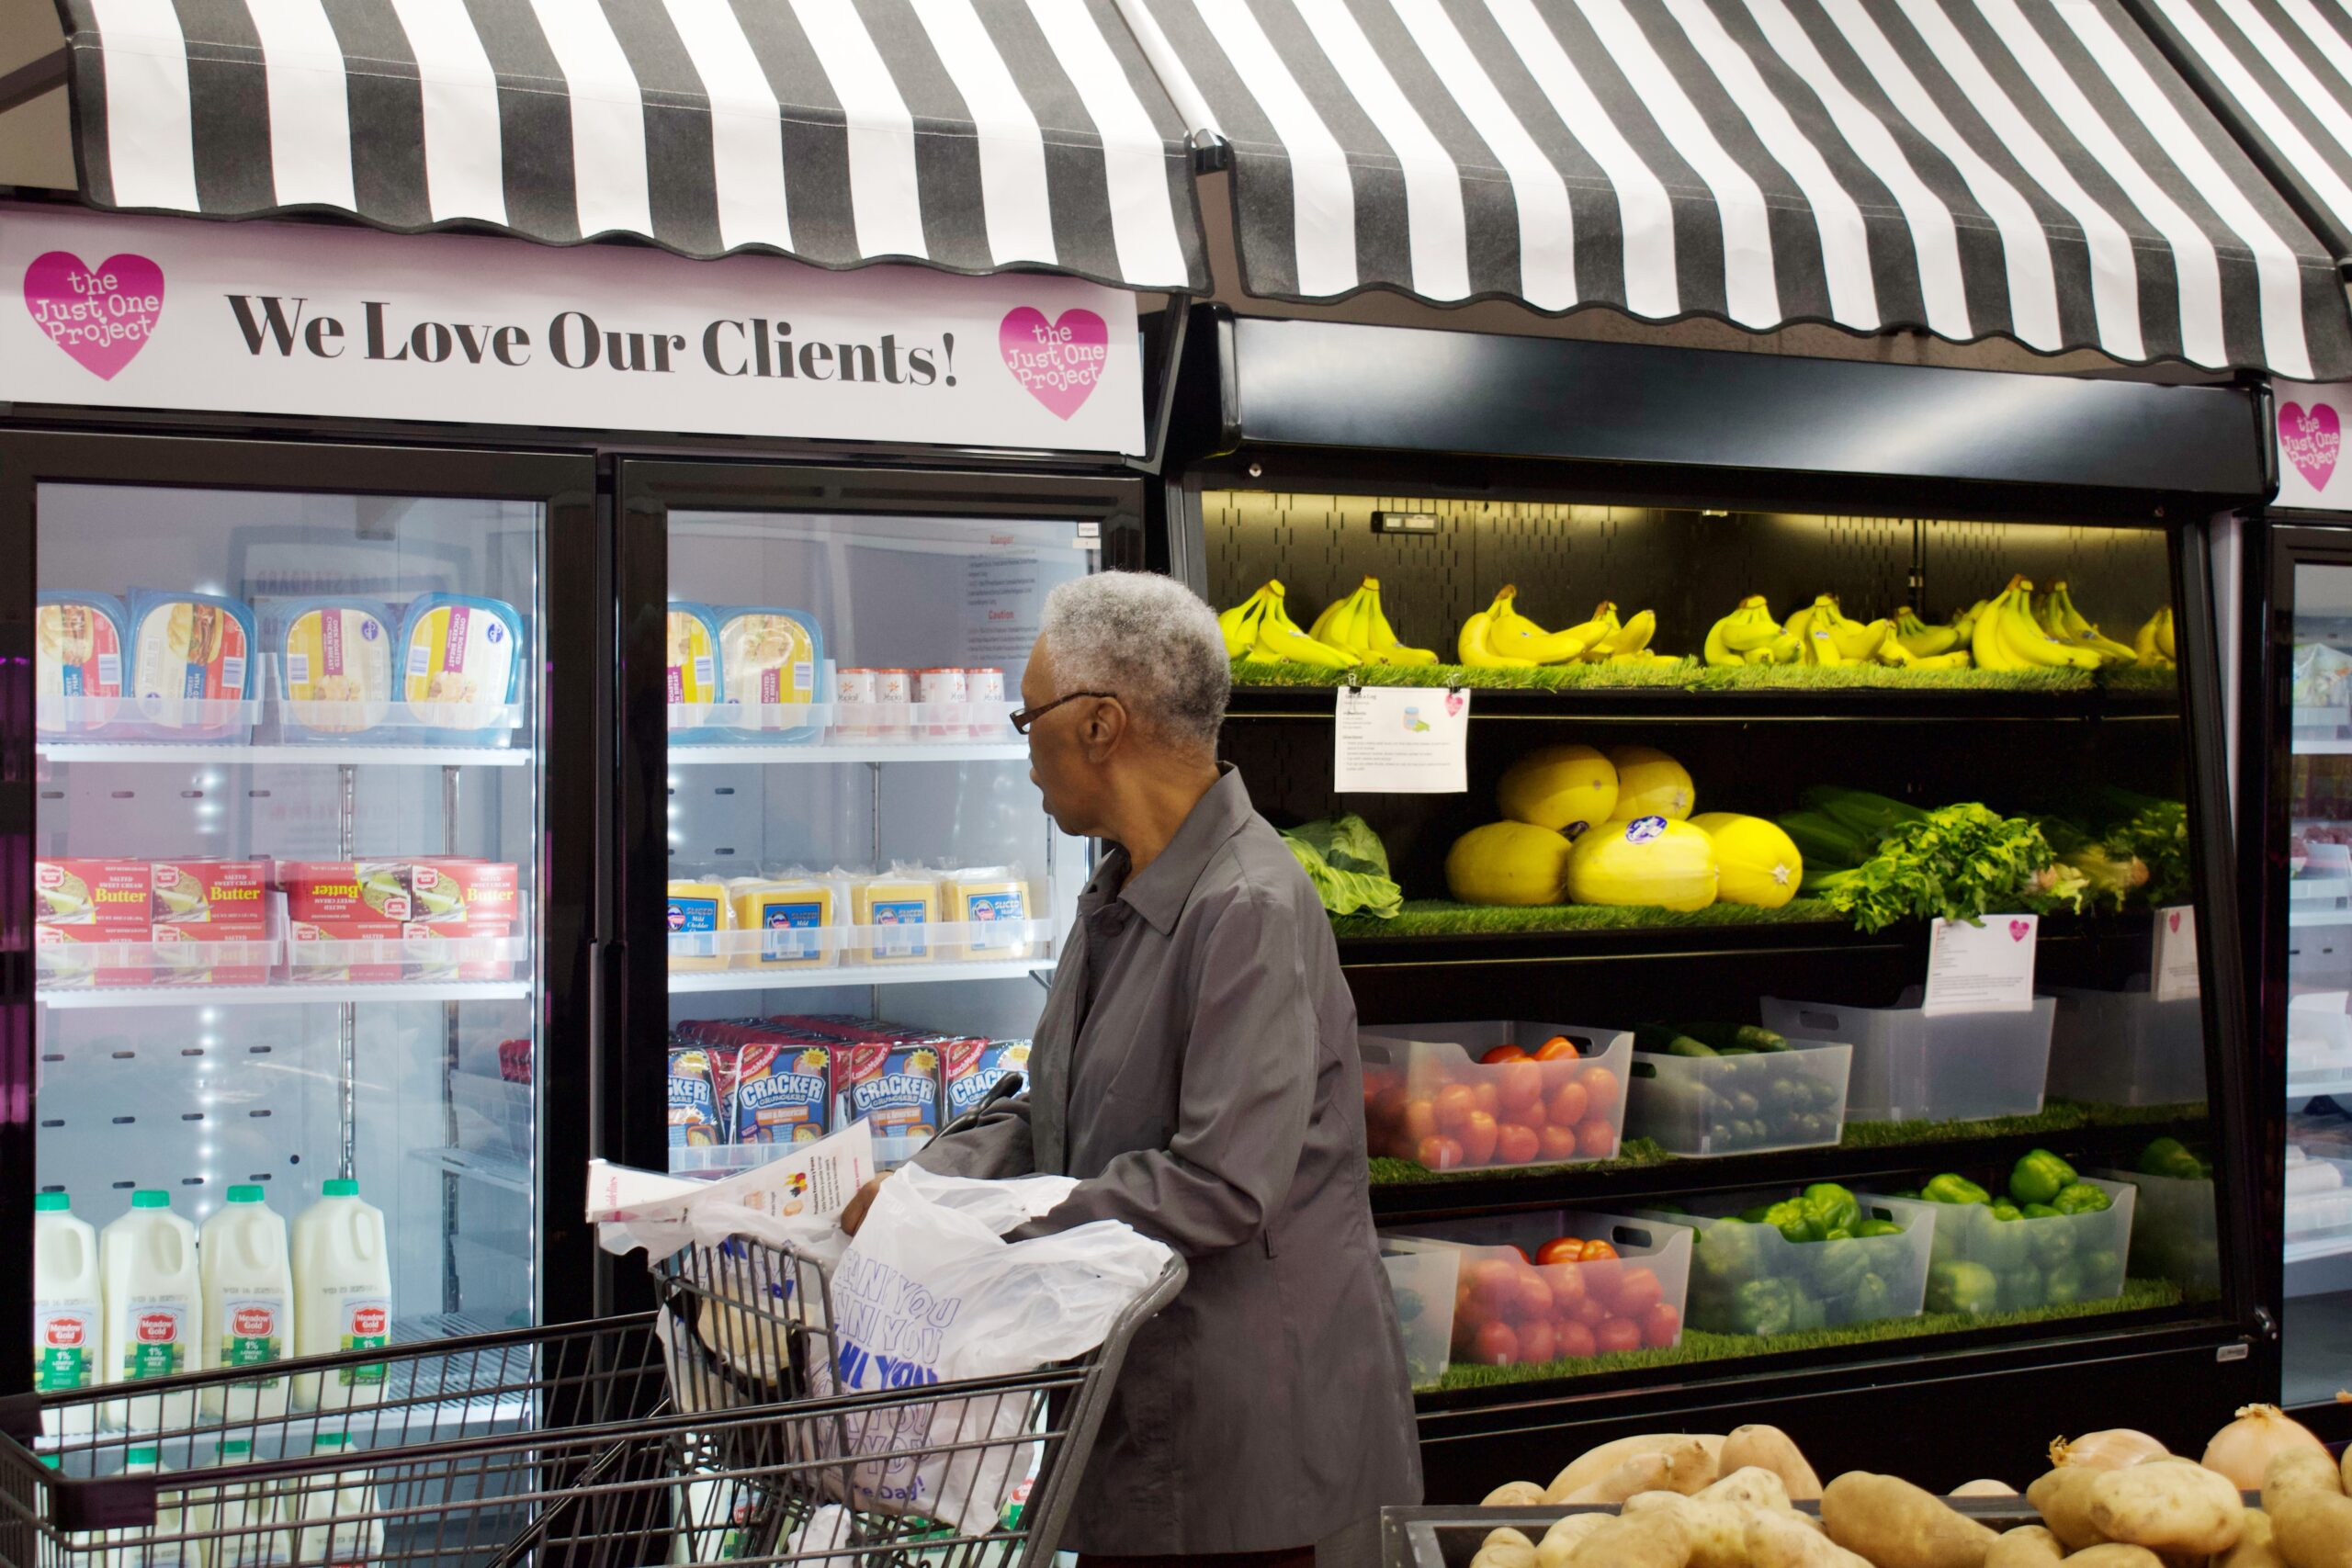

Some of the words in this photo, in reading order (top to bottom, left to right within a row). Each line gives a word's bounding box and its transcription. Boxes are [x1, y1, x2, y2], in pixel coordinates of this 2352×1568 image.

[67, 272, 119, 295] the
[35, 296, 103, 322] Just
[108, 294, 159, 317] One
[47, 314, 155, 347] Project
[1032, 324, 1072, 345] the
[223, 294, 345, 358] We
[361, 300, 531, 367] Love
[548, 310, 685, 374] Our
[702, 317, 956, 387] Clients!
[1008, 346, 1060, 369] Just
[1065, 344, 1104, 365] One
[1017, 362, 1102, 391] Project
[2296, 415, 2320, 433] the
[2283, 433, 2314, 452] Just
[2316, 432, 2339, 448] One
[2289, 446, 2338, 469] Project
[989, 610, 1014, 619] Caution
[96, 887, 147, 903] Butter
[210, 886, 261, 900] Butter
[312, 885, 359, 898] Butter
[467, 887, 514, 901] Butter
[994, 900, 1020, 908] SLICED
[686, 907, 714, 916] SLICED
[741, 1074, 823, 1108] CRACKER
[854, 1075, 934, 1109] CRACKER
[894, 1275, 962, 1328] YOU
[142, 1320, 172, 1328] Meadow
[238, 1314, 268, 1323] Meadow
[243, 1321, 263, 1329] Gold
[356, 1314, 384, 1322] Meadow
[362, 1321, 379, 1329] Gold
[50, 1324, 82, 1332] Meadow
[56, 1331, 74, 1339] Gold
[148, 1327, 166, 1336] Gold
[245, 1341, 259, 1350] 1%
[883, 1314, 944, 1364] YOU
[56, 1350, 71, 1359] 1%
[148, 1347, 163, 1357] 1%
